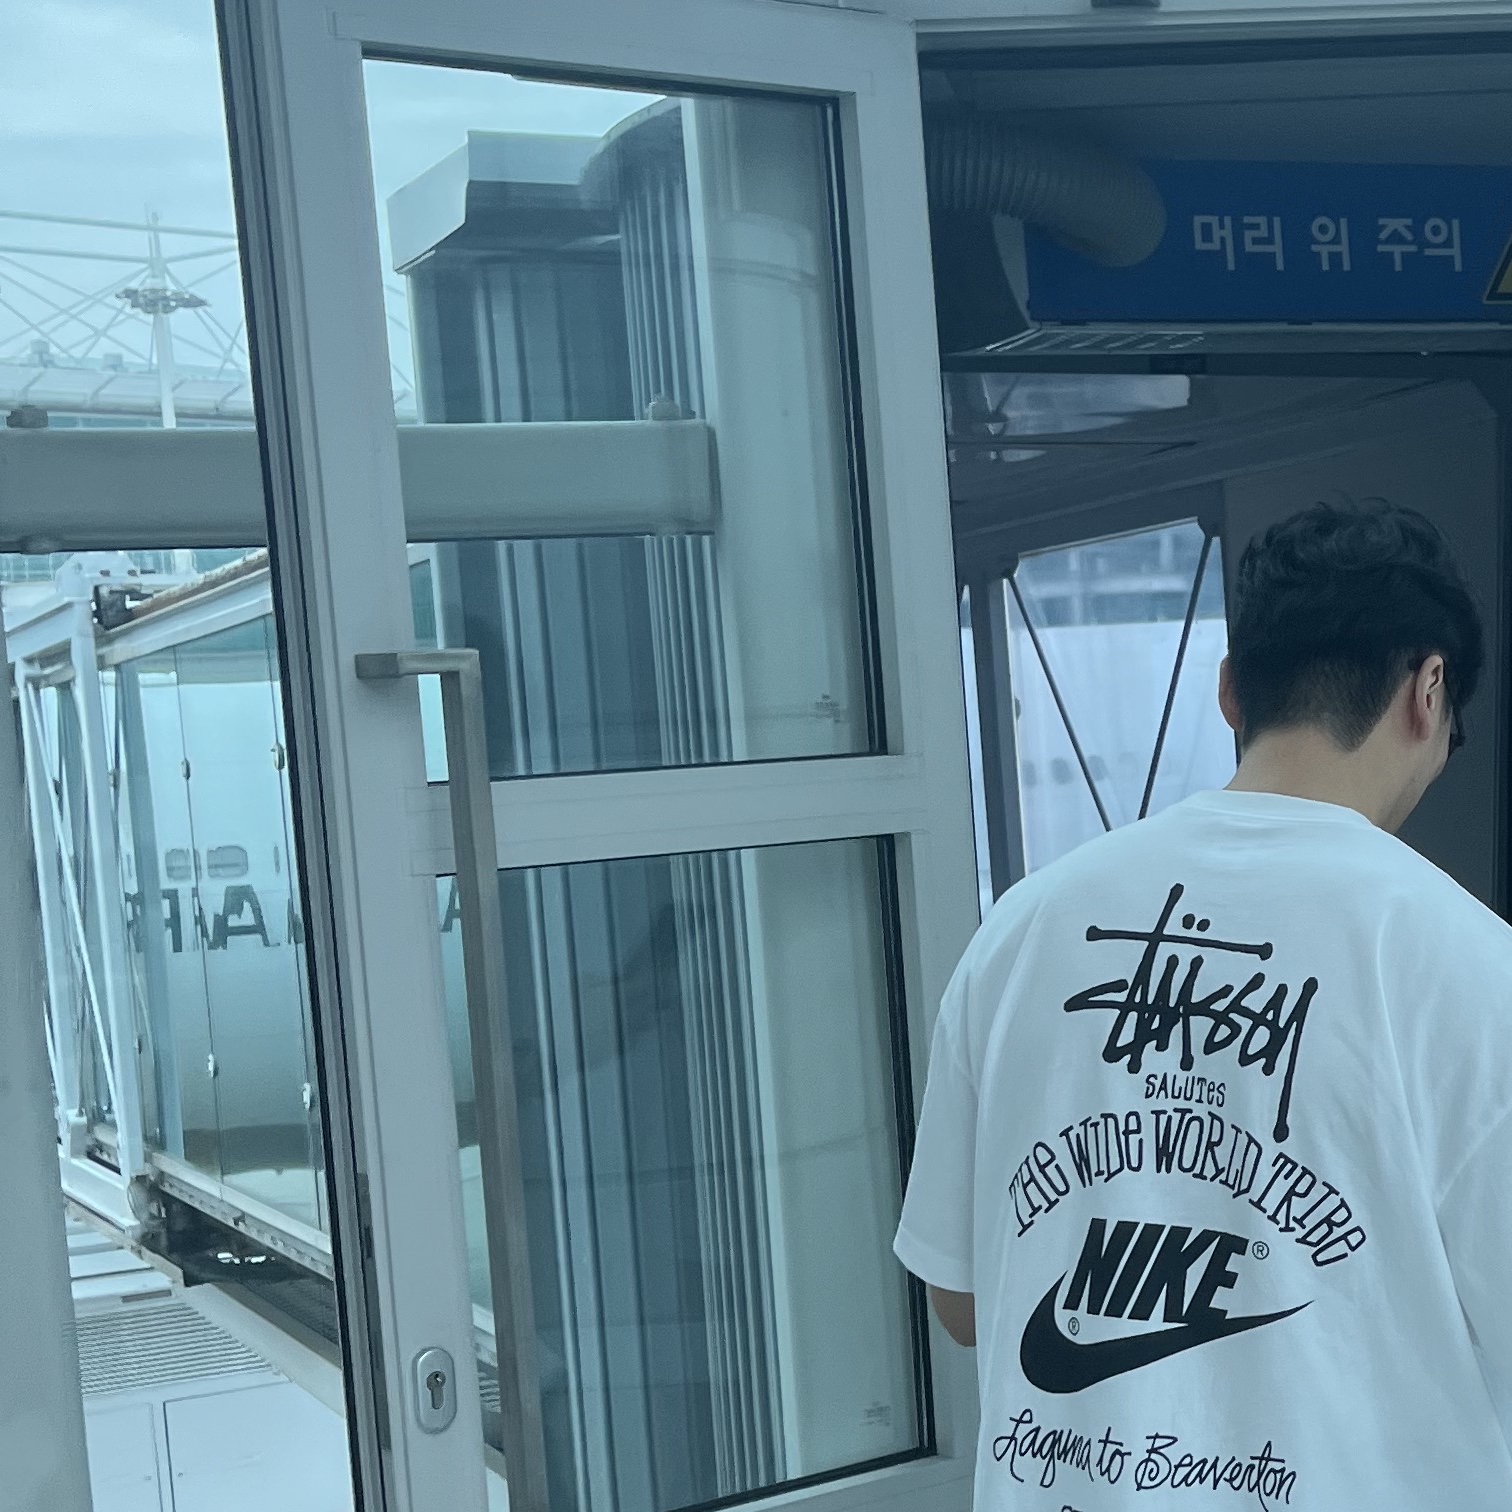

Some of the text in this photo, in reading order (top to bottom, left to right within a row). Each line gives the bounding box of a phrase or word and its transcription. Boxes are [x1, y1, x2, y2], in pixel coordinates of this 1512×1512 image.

[1193, 215, 1463, 272] 머리 위 주의
[1150, 1107, 1264, 1199] WORLD
[1062, 1217, 1250, 1325] NIKE
[992, 1408, 1095, 1489] Laguna
[1095, 1426, 1132, 1485] to
